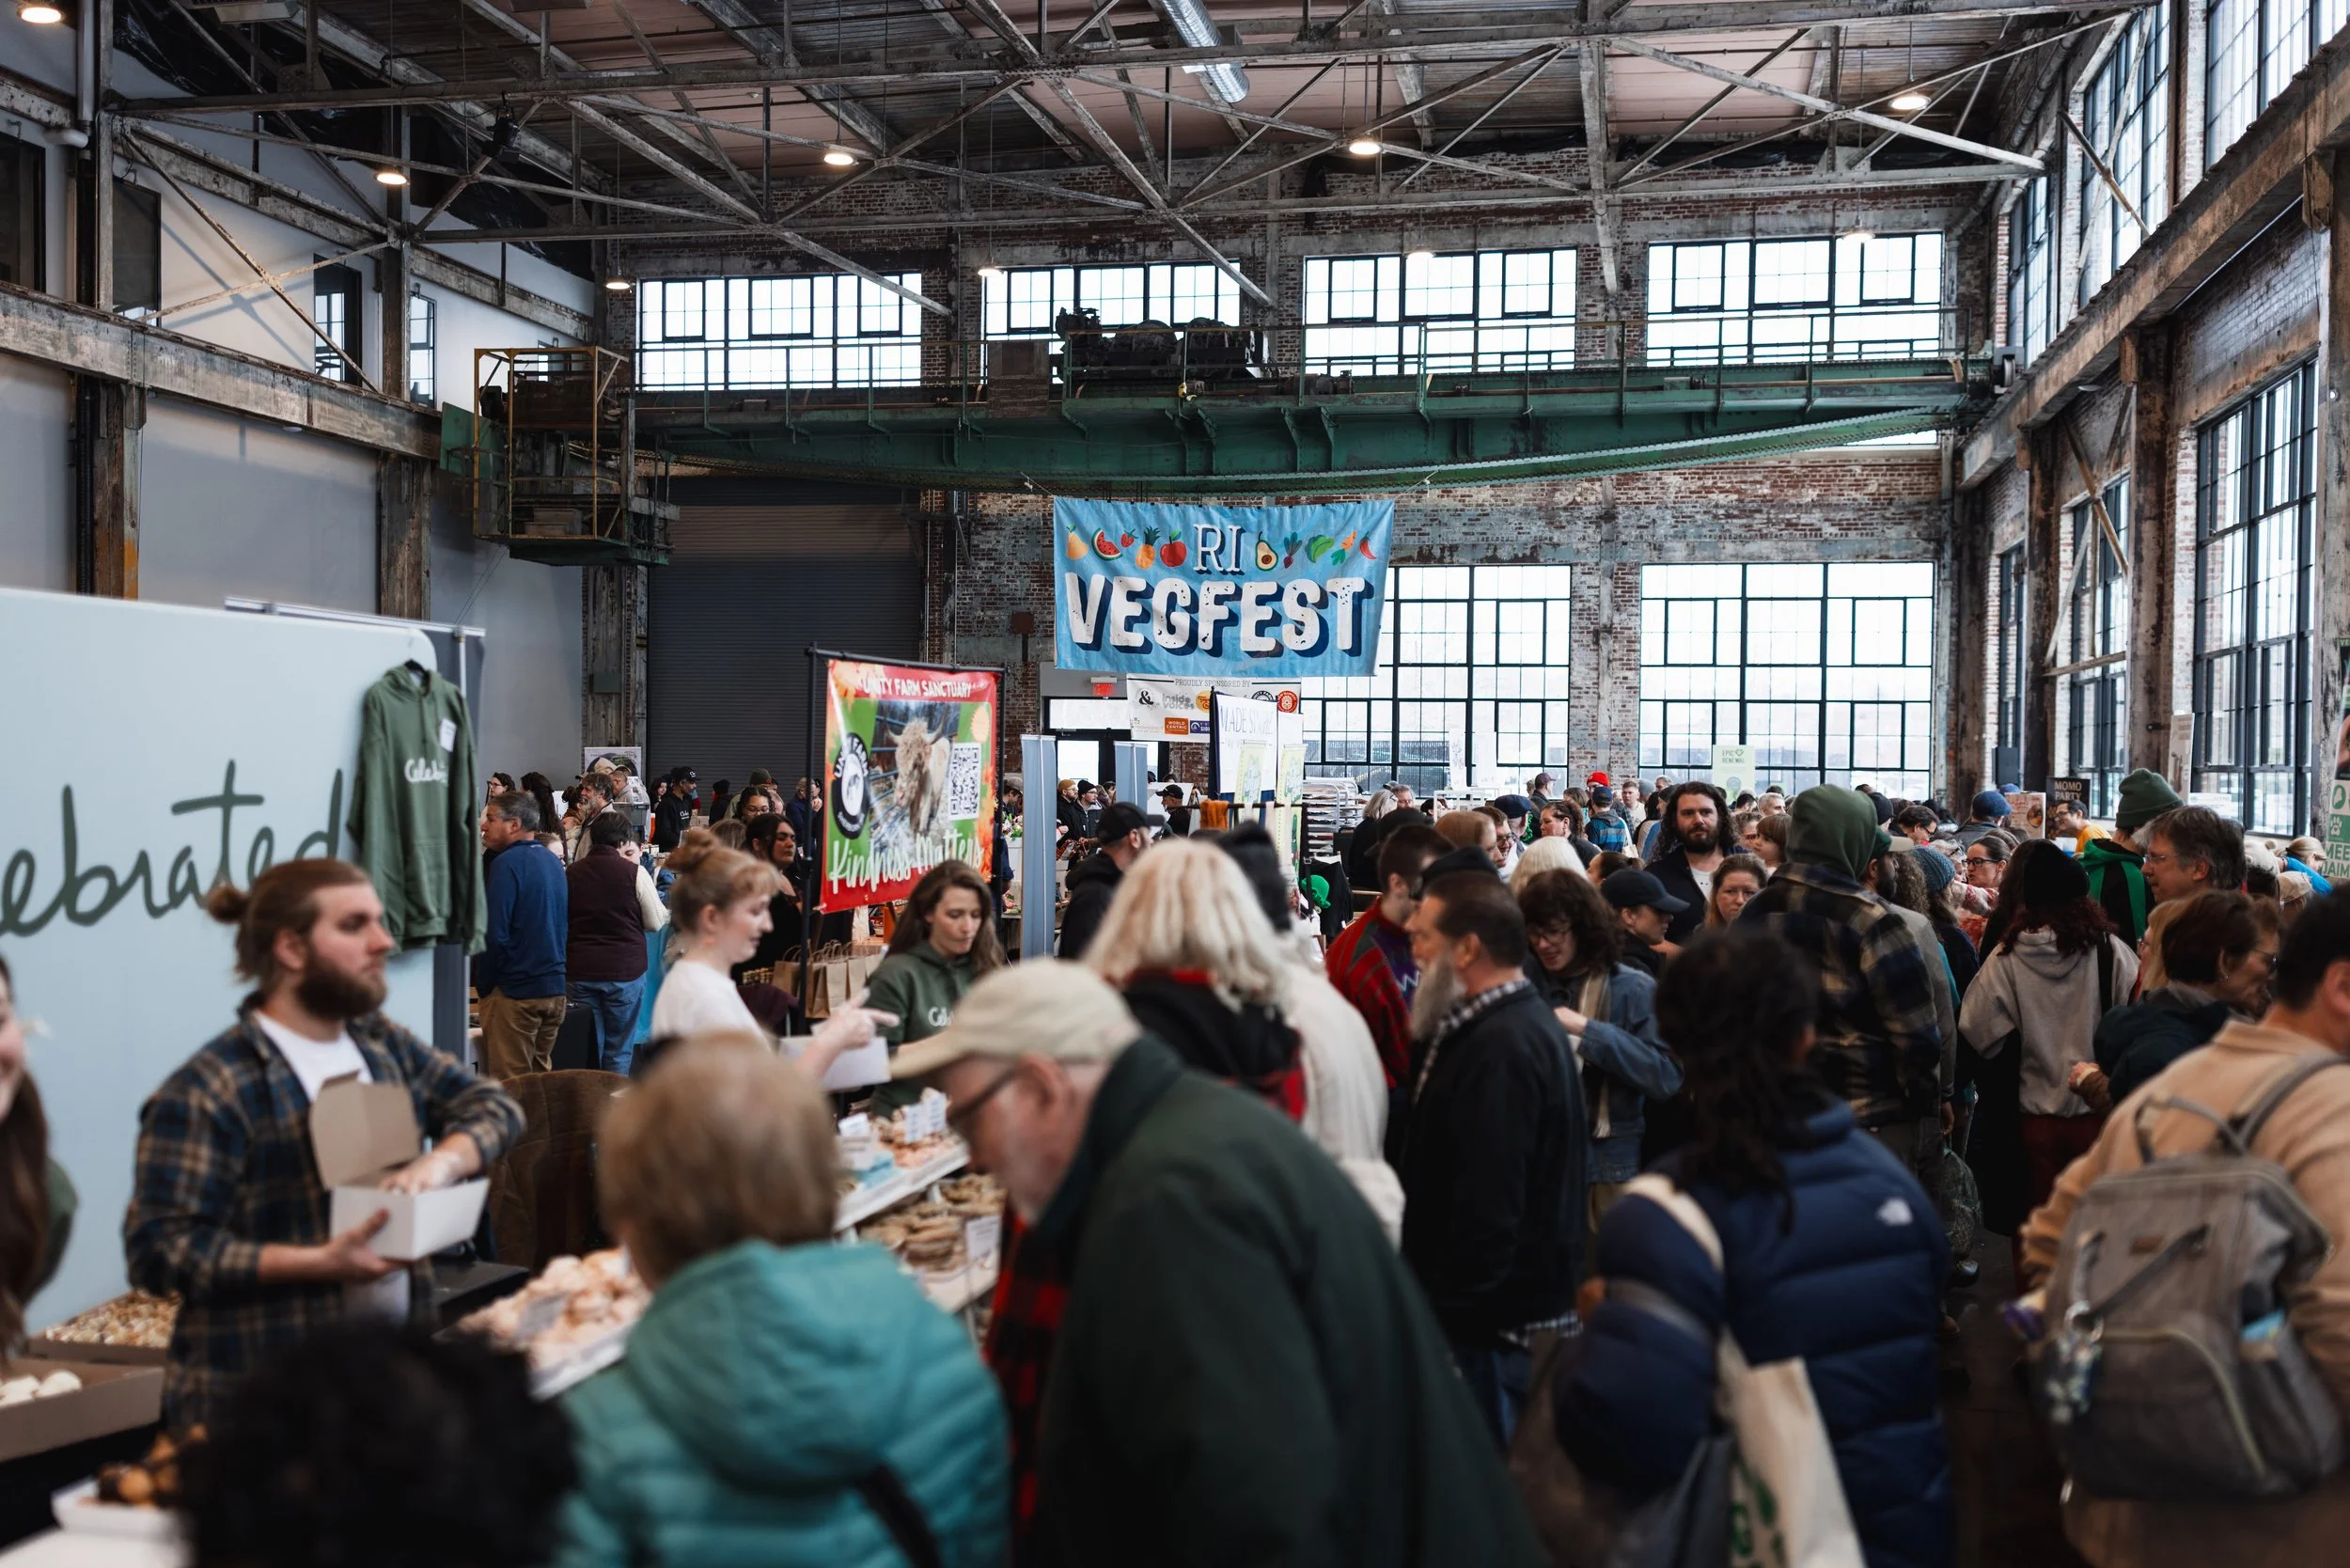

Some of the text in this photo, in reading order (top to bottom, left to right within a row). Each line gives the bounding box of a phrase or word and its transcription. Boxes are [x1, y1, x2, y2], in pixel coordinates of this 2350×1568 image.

[1193, 524, 1246, 575] RI
[1065, 572, 1372, 657] VEGFEST
[895, 678, 920, 697] FARM
[923, 679, 971, 698] SANCTUARY
[1175, 678, 1203, 687] PROUDLY
[1204, 679, 1241, 687] SPONSORED
[2055, 780, 2082, 791] MOMO
[2055, 792, 2082, 801] PARTY
[828, 838, 912, 895] Kindness
